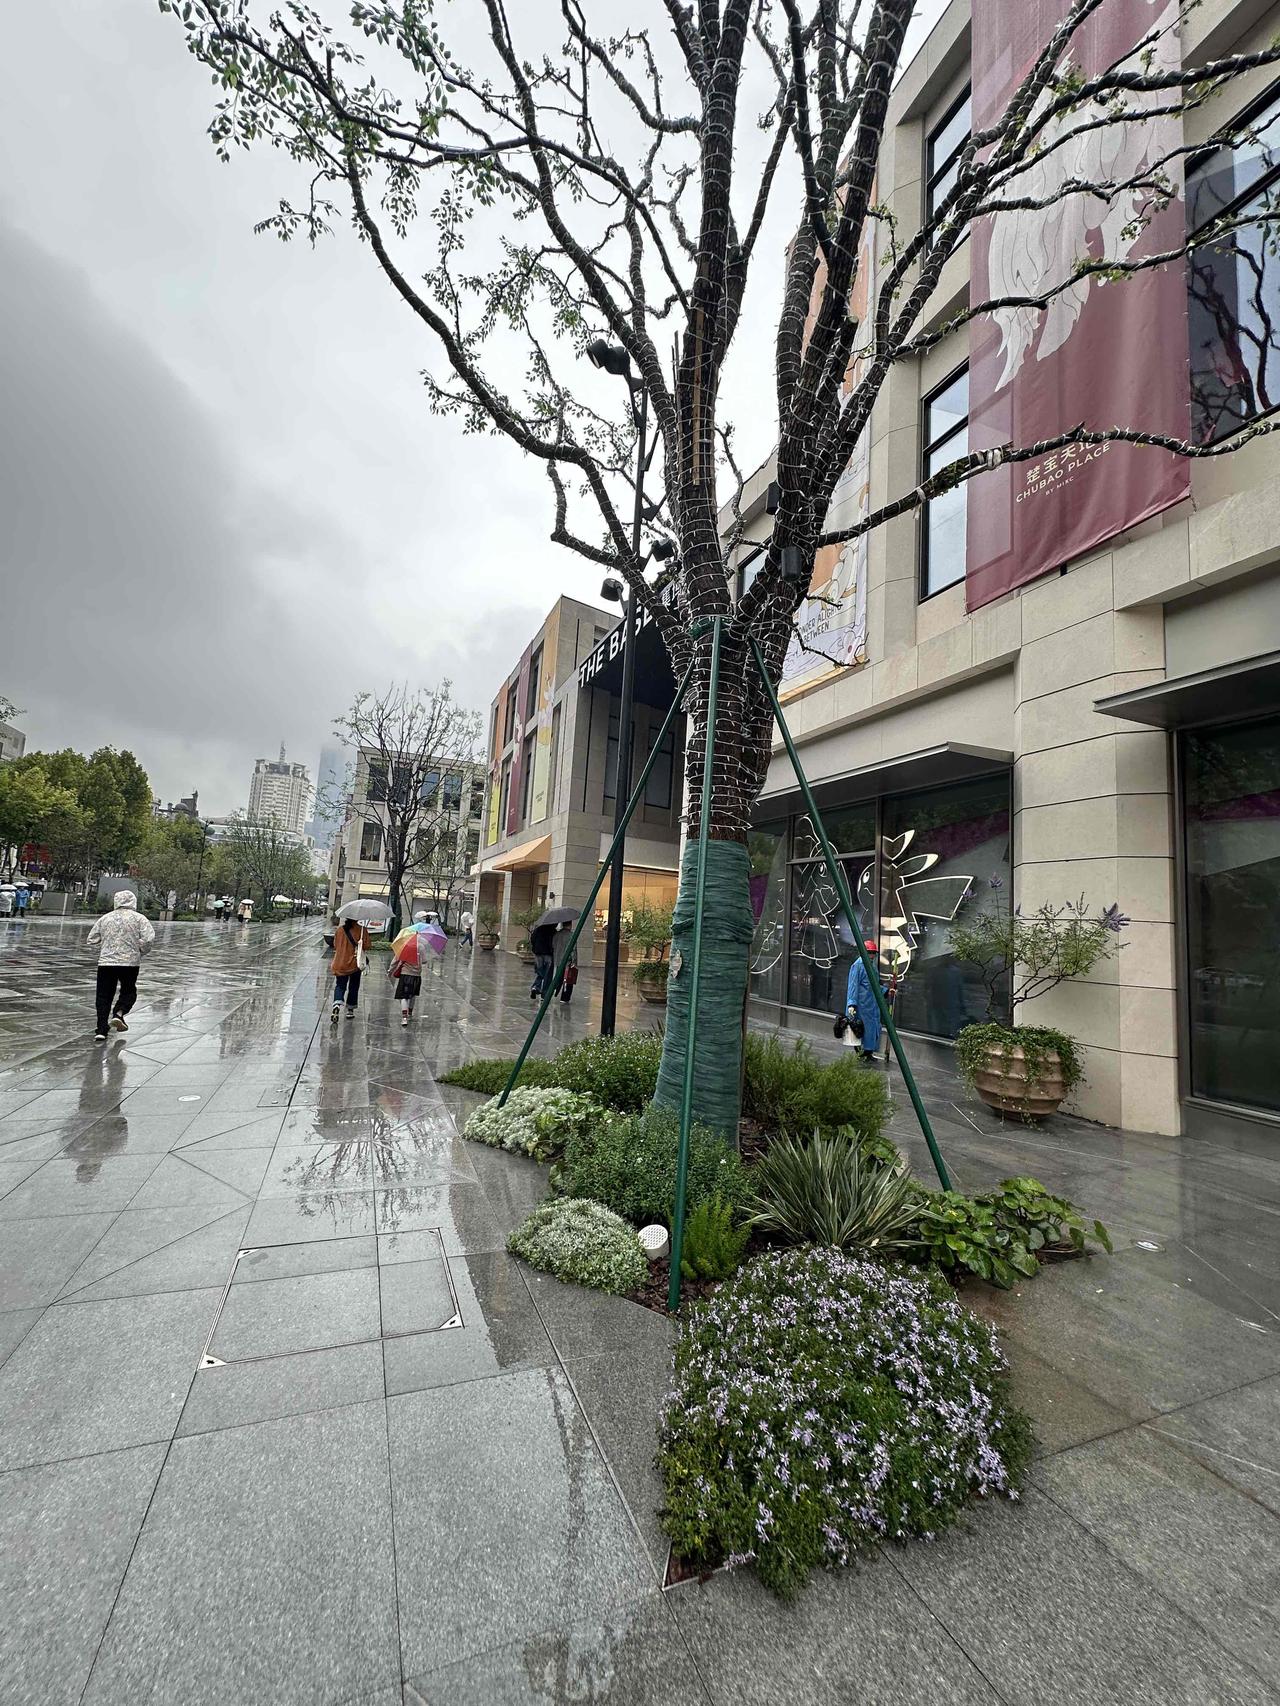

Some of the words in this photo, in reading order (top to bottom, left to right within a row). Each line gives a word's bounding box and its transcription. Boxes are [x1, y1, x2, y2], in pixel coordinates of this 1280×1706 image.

[1016, 469, 1063, 502] CHUBAO
[1068, 441, 1110, 472] PLACE
[1045, 488, 1055, 496] BY
[803, 621, 830, 642] BETWEEN
[580, 644, 605, 688] THE
